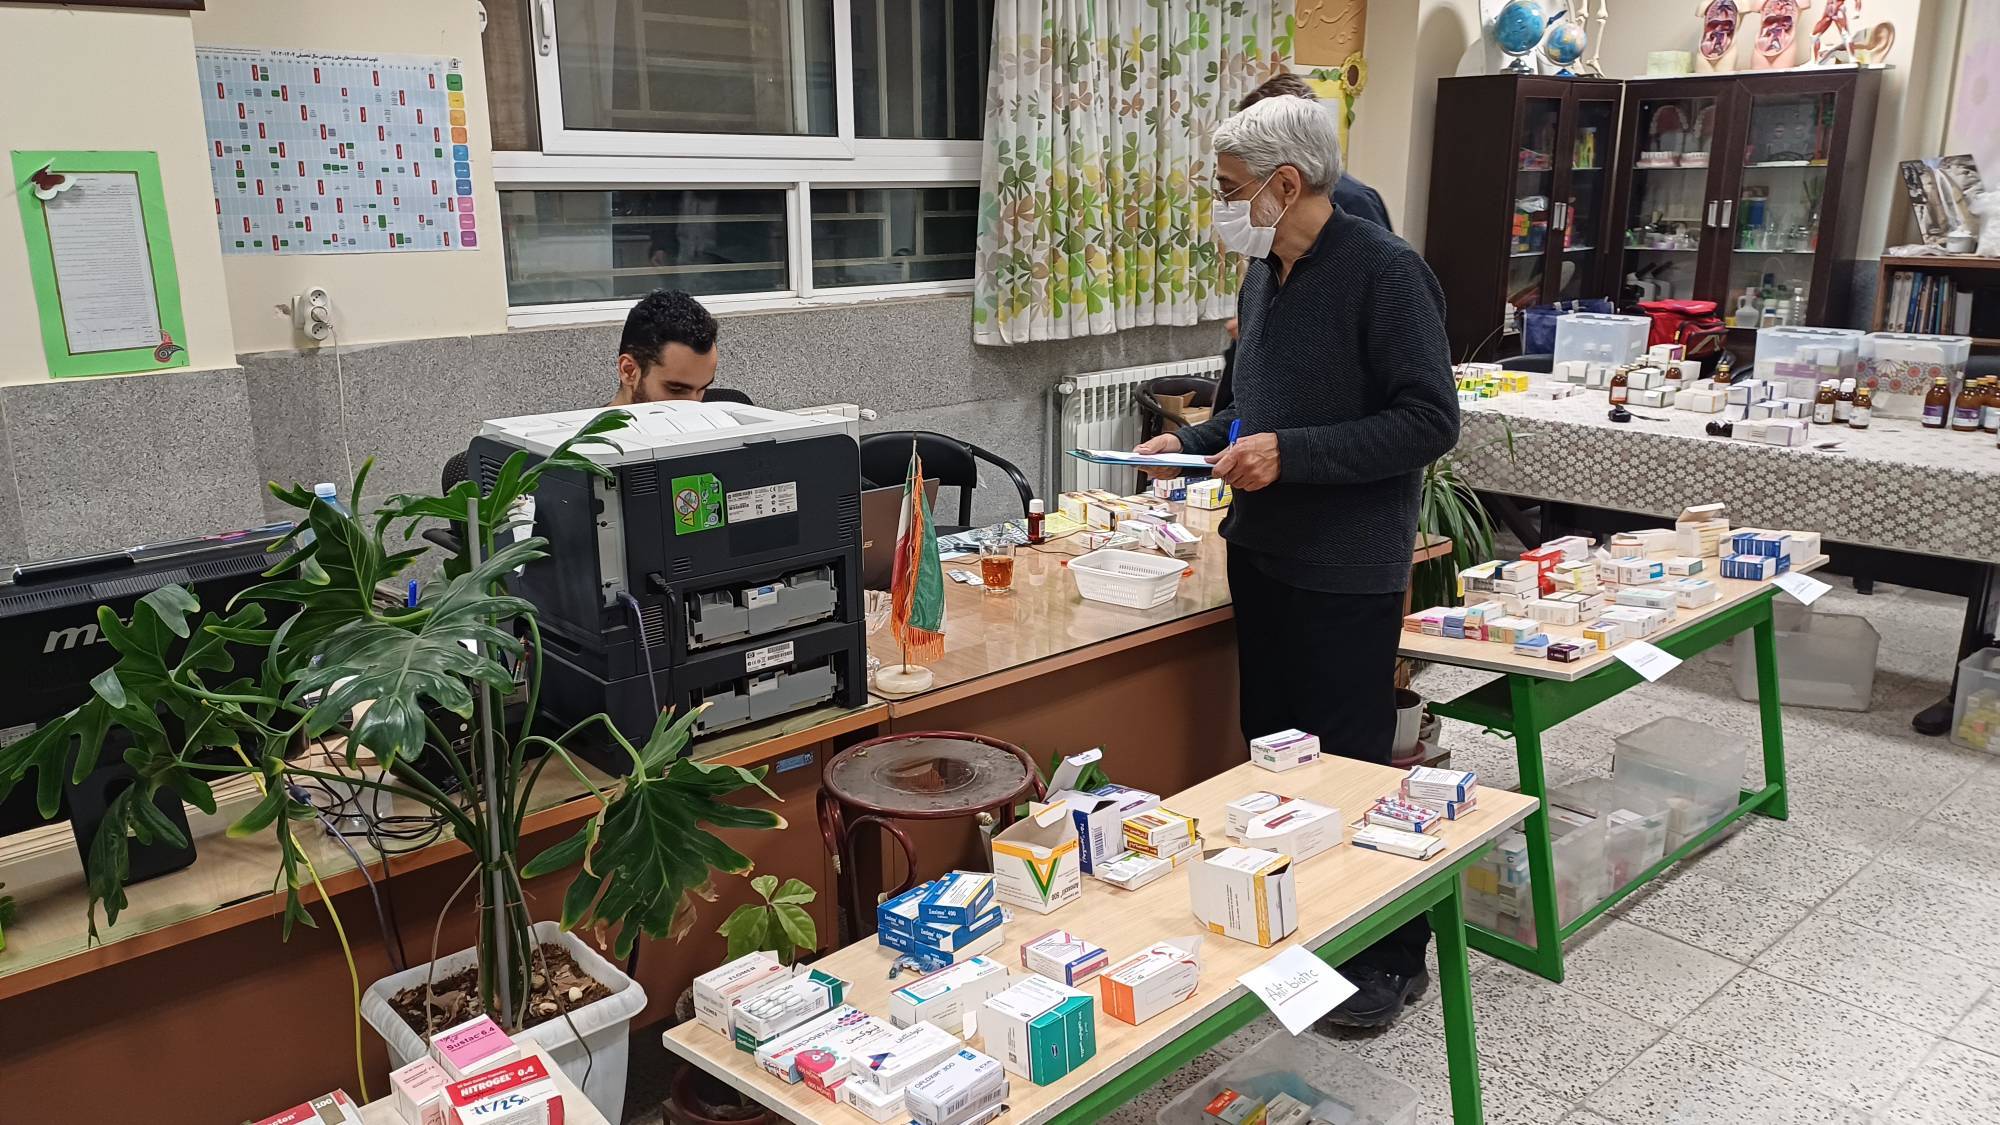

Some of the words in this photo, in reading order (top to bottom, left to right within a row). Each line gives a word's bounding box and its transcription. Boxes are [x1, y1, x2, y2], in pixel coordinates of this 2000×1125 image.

[460, 1074, 512, 1098] NITROGEL
[517, 1065, 534, 1077] 0.4
[314, 1098, 333, 1109] 100
